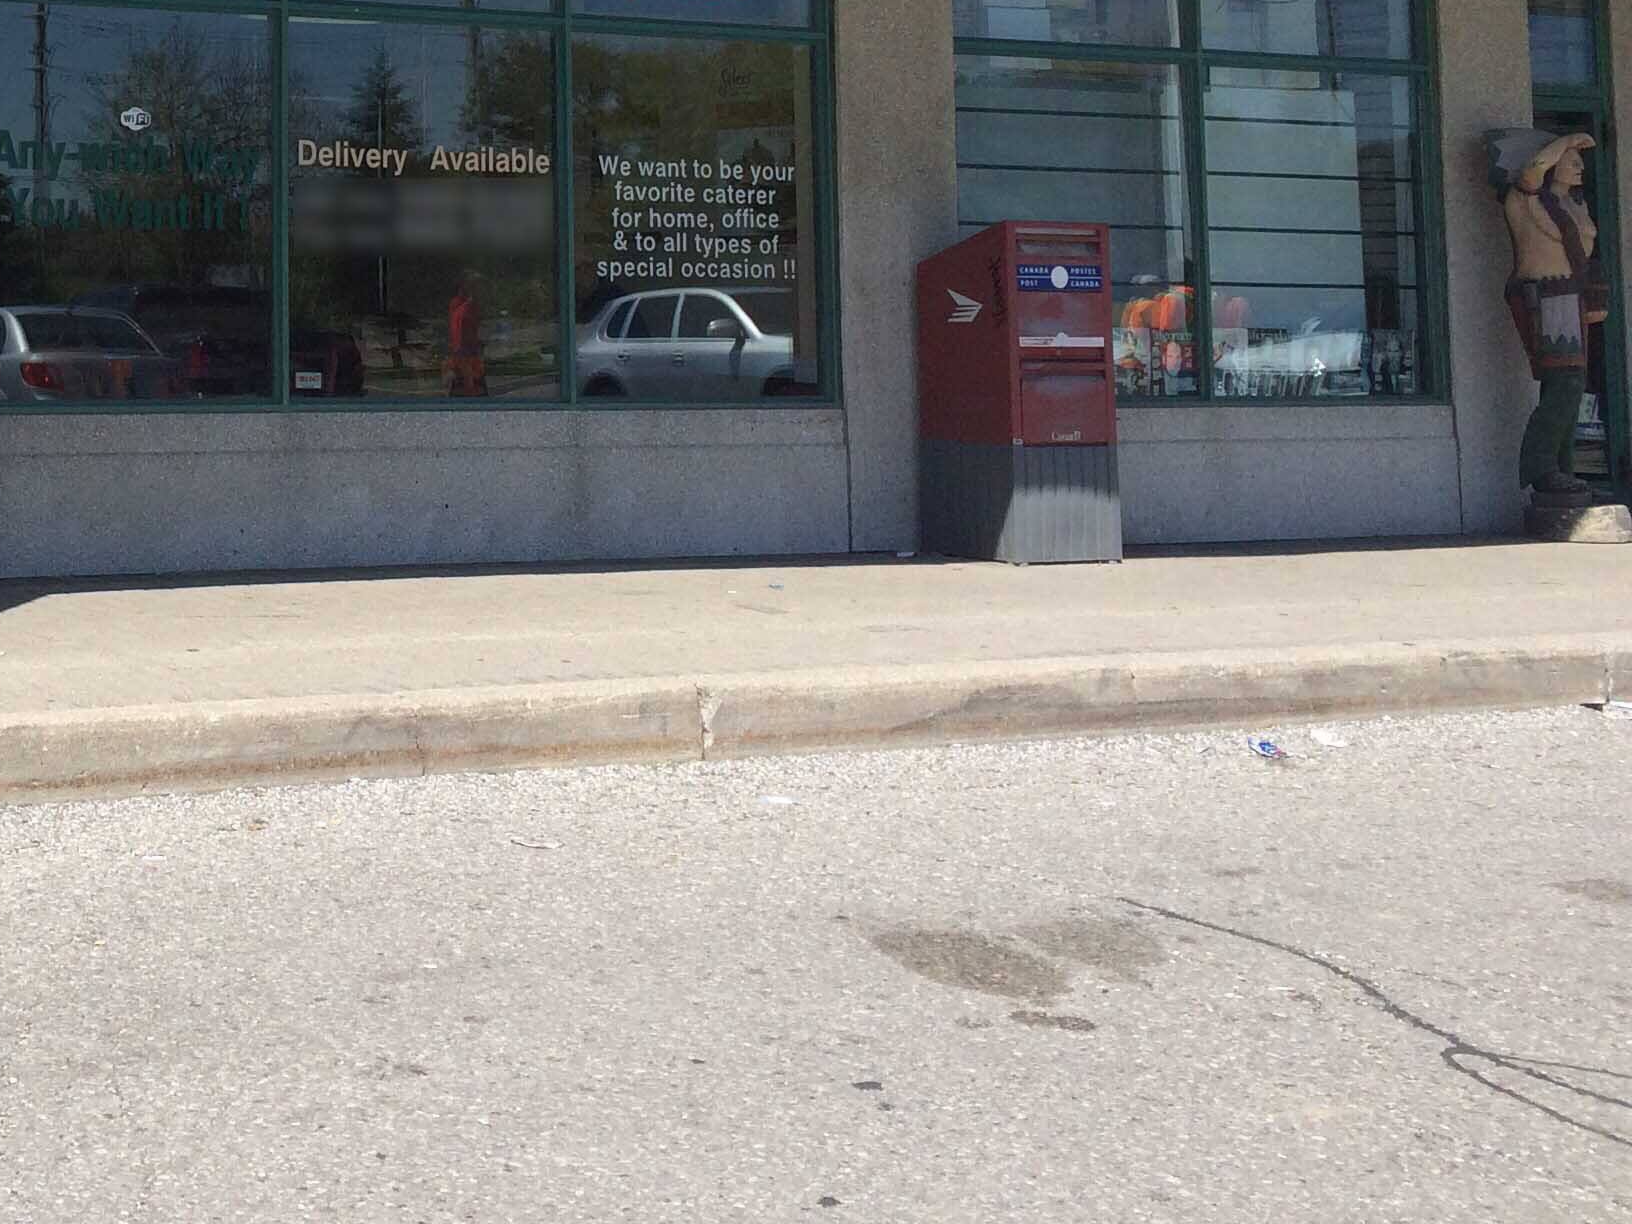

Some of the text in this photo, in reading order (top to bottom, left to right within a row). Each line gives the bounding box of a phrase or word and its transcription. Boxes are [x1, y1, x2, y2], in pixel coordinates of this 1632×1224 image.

[297, 139, 551, 177] Delivery Available
[598, 154, 796, 186] We want to be your
[614, 180, 778, 206] favorite caterer
[611, 207, 780, 232] for home, office
[613, 230, 780, 259] & to all types of
[596, 256, 797, 282] special occasion !!
[1018, 266, 1049, 275] CANADA
[1019, 279, 1100, 288] POST CANADA
